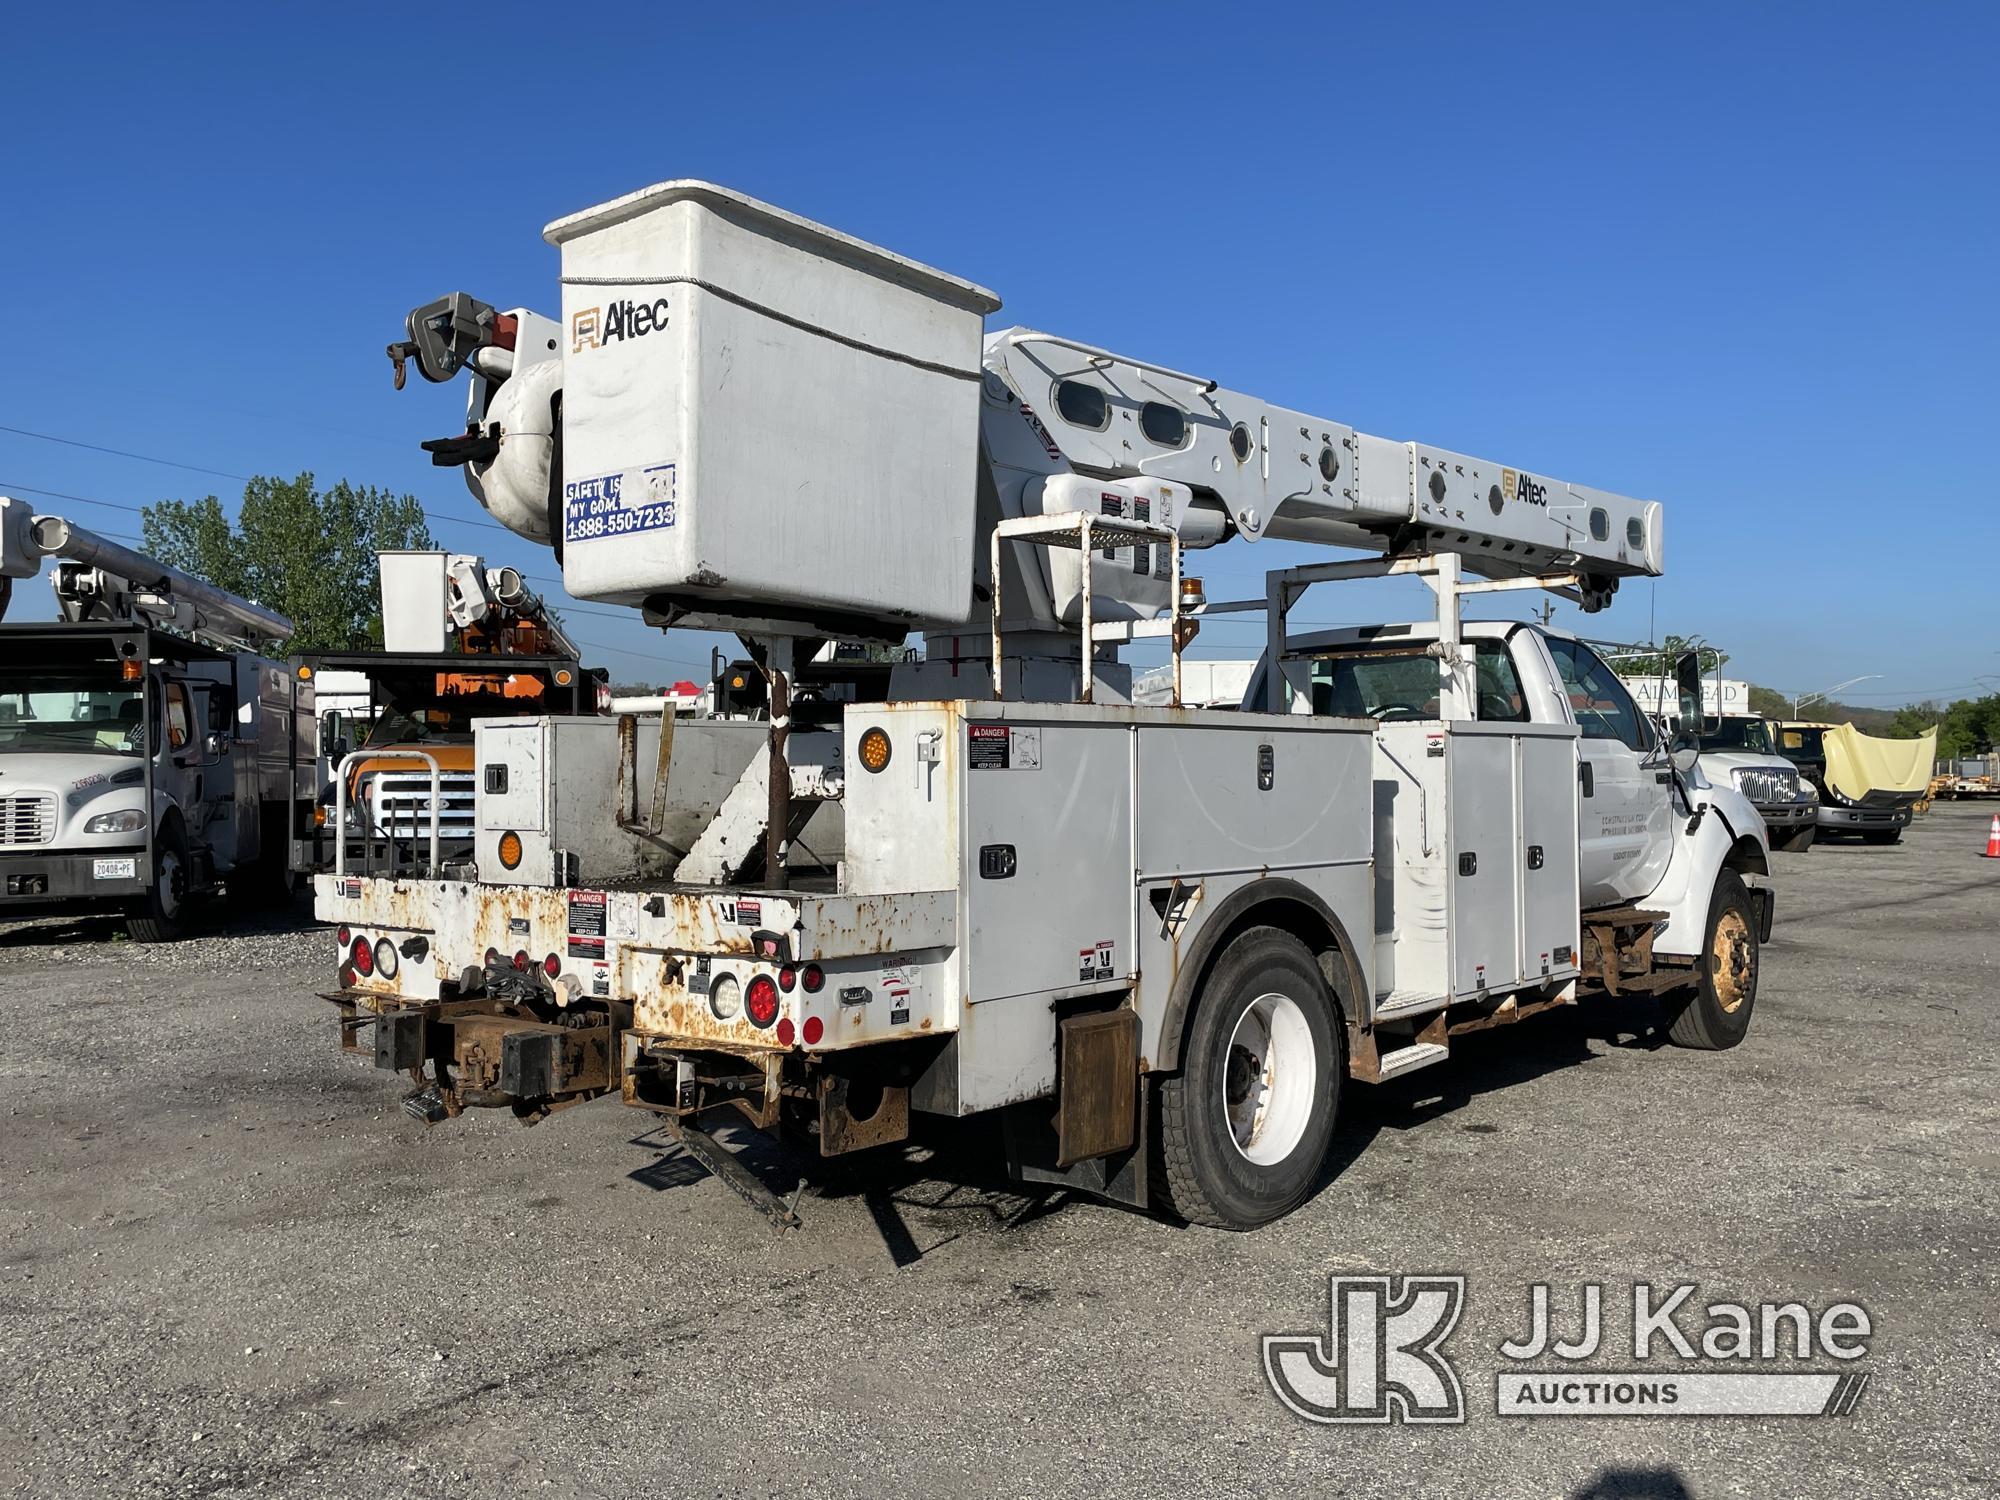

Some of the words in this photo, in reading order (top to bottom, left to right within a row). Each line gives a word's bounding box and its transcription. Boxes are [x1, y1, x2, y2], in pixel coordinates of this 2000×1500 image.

[601, 298, 669, 346] Altec
[568, 479, 606, 500] SAFETY
[610, 477, 621, 494] IS
[1517, 473, 1547, 507] Altec
[569, 501, 586, 519] MY
[590, 497, 618, 515] GOAL
[1637, 683, 1737, 701] ALMEAD
[980, 728, 1005, 737] DANGER
[579, 894, 603, 903] DANGER
